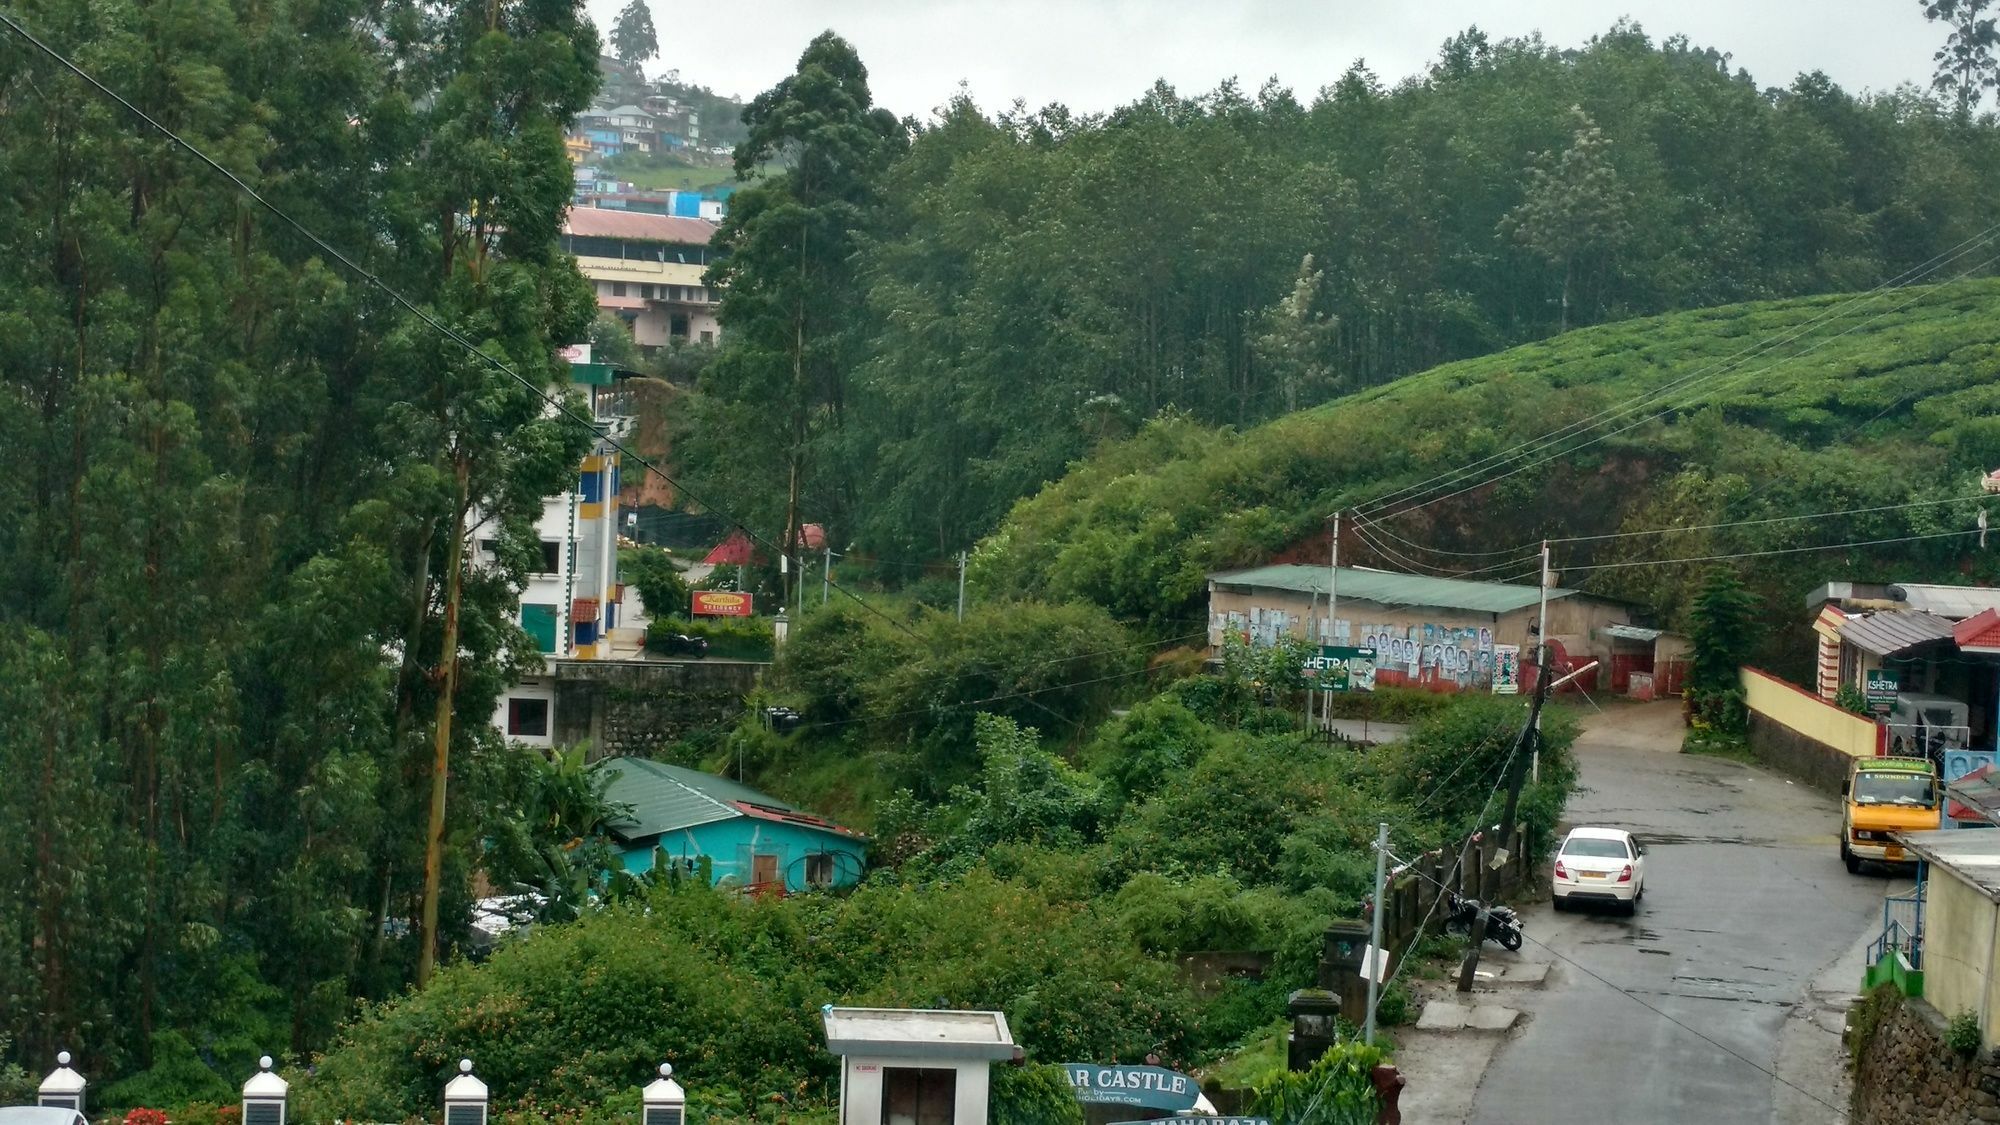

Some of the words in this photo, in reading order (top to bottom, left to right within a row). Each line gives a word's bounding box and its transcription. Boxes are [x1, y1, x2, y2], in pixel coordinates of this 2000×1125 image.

[1867, 680, 1897, 690] KSHETRA
[1098, 1069, 1187, 1095] CASTLE
[1093, 1088, 1105, 1096] by
